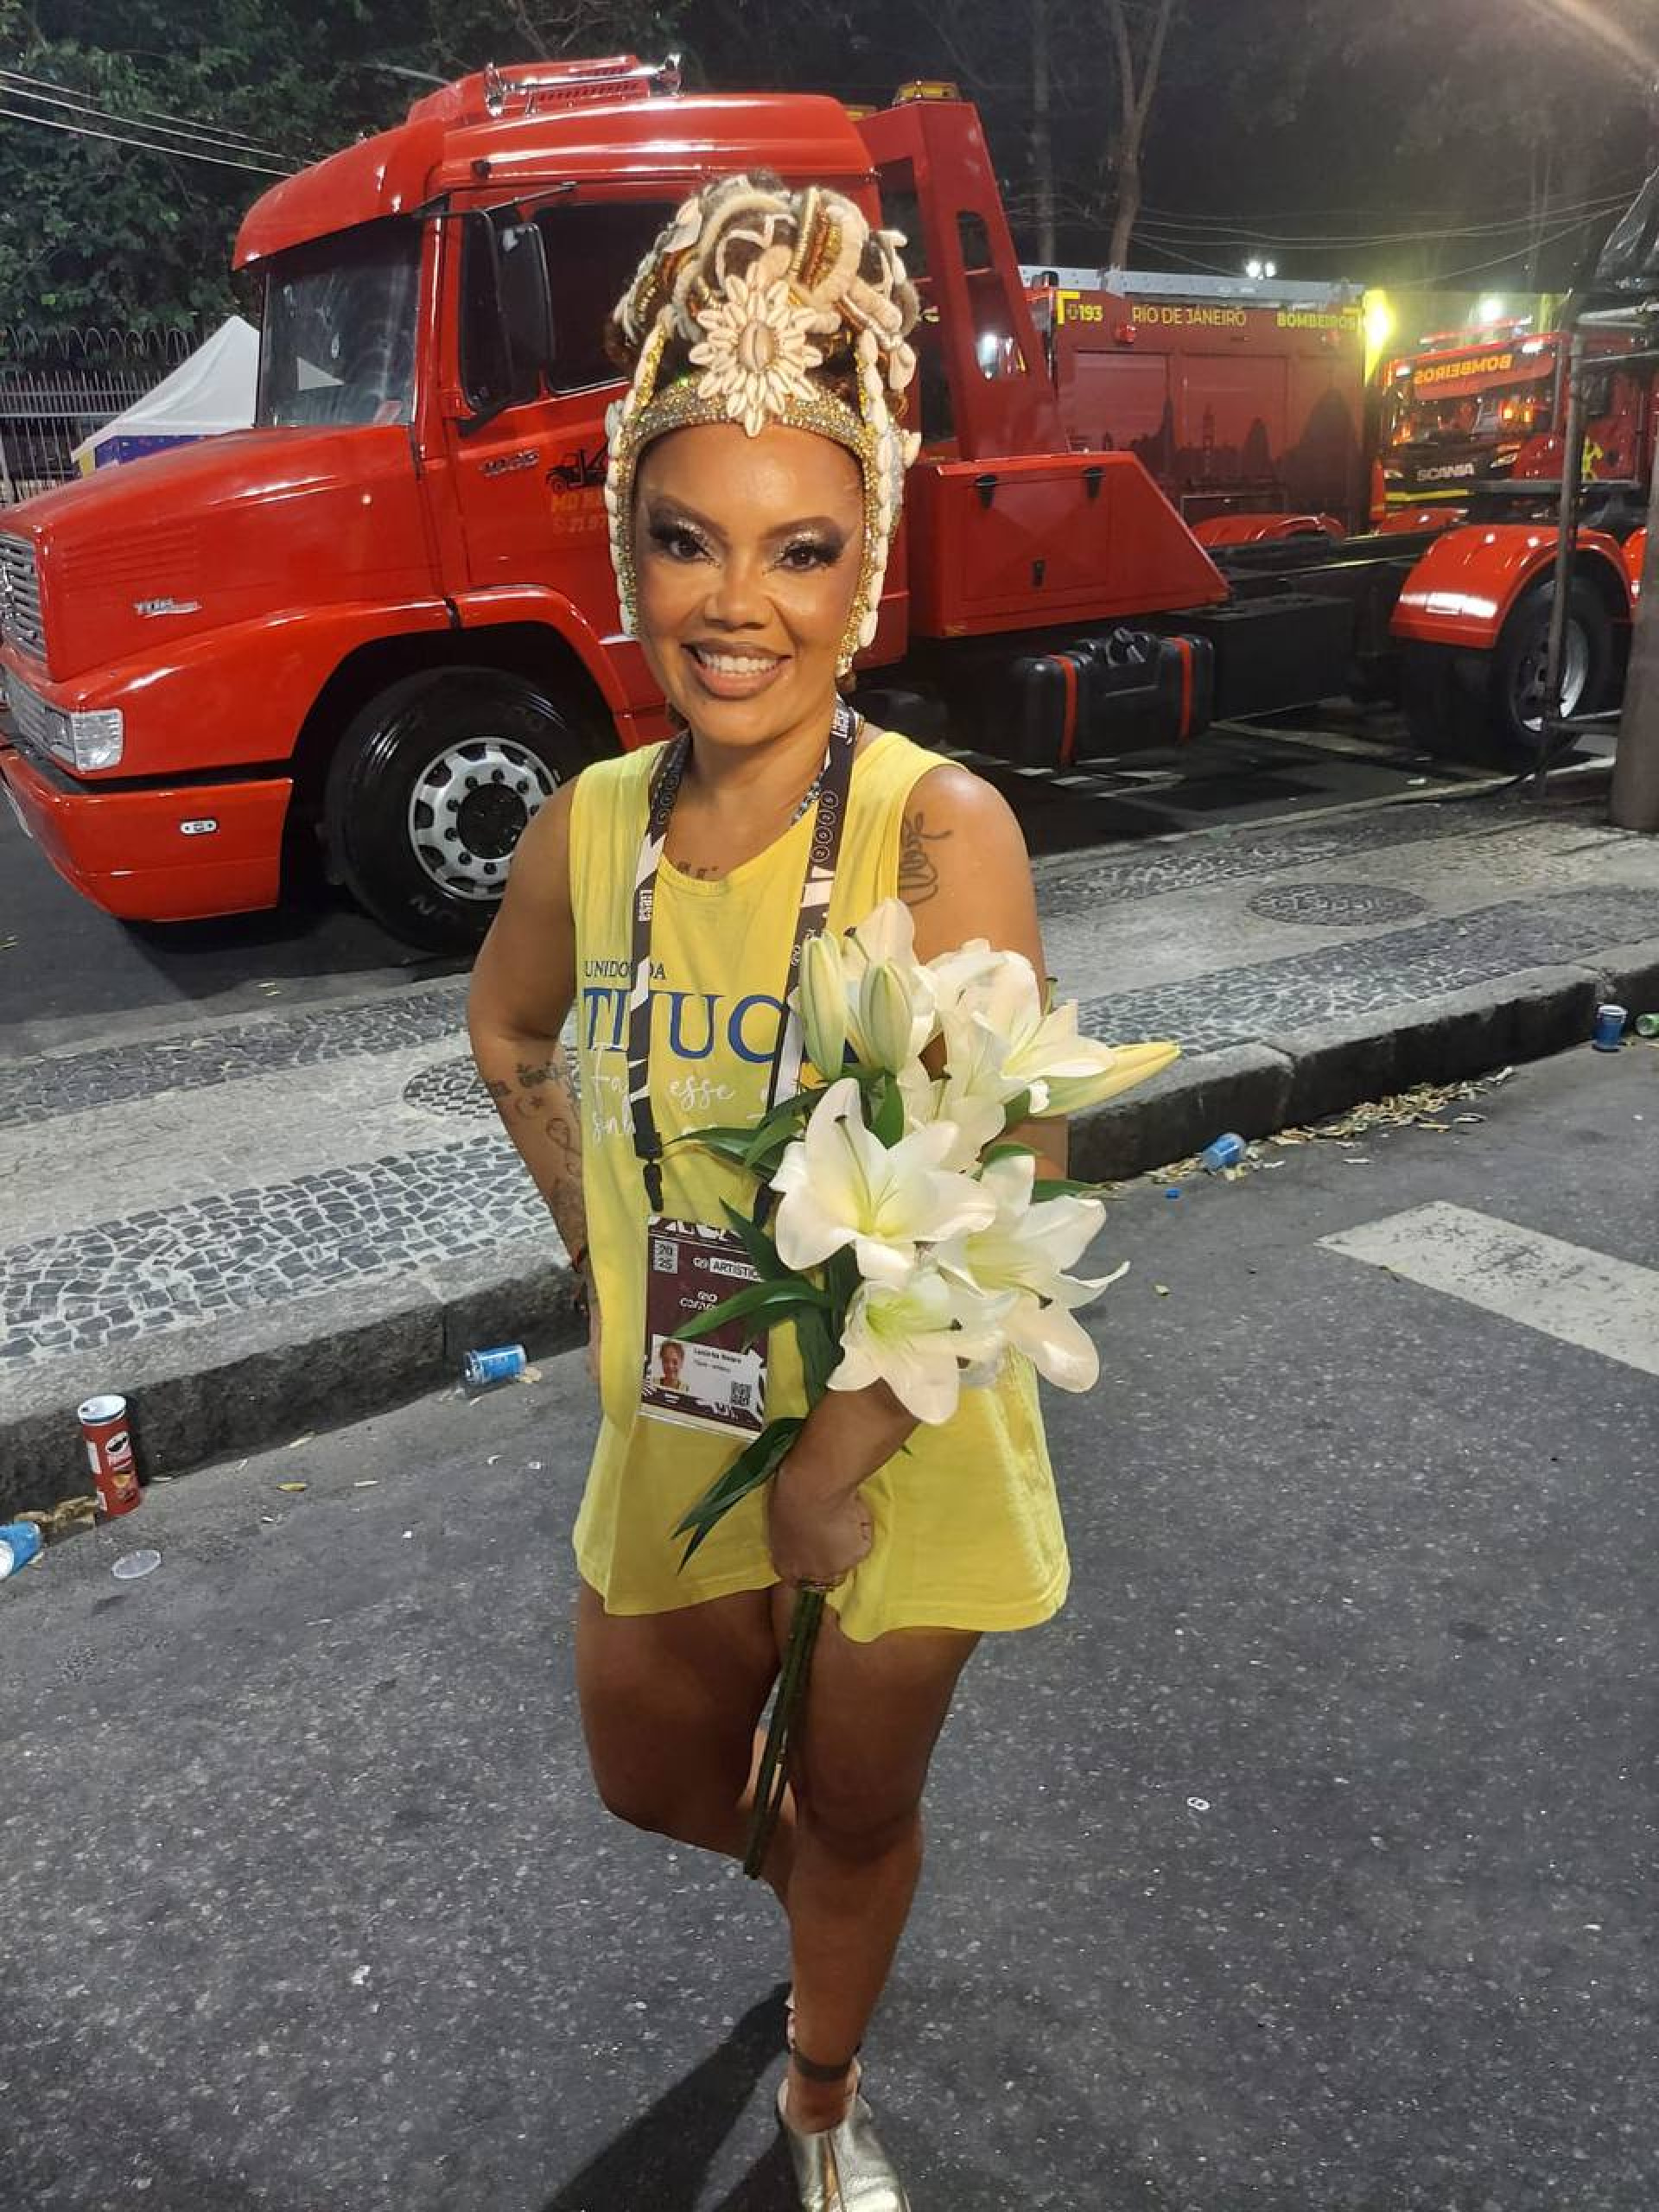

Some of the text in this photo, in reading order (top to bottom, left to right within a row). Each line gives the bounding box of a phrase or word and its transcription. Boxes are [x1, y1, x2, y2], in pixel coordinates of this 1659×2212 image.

[1078, 305, 1103, 322] 193
[1133, 306, 1246, 327] RIO DE JANEIRO
[1276, 311, 1357, 329] BOMBEIROS
[584, 959, 631, 978] UNIDO
[582, 987, 821, 1064] TIUC
